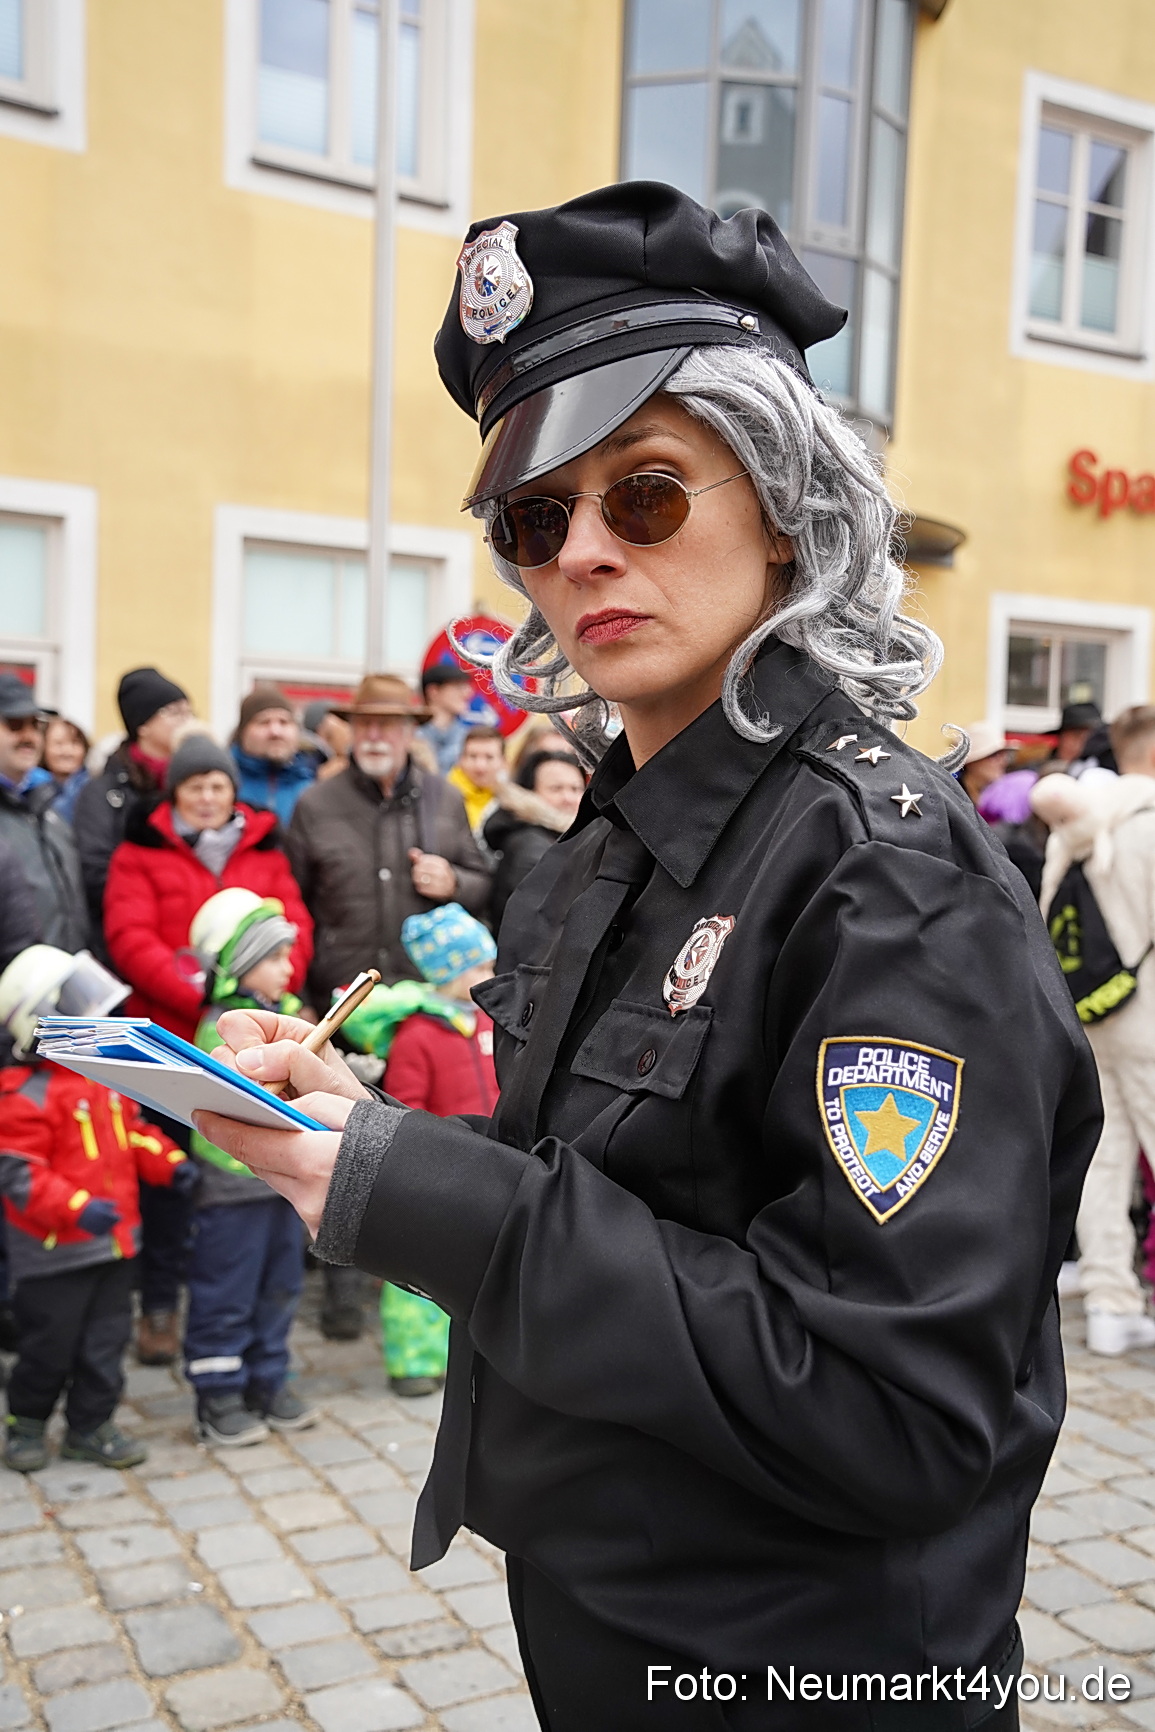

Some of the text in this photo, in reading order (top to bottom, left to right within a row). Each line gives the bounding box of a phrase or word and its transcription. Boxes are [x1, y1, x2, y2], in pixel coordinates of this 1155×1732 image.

[466, 239, 503, 265] SPECIAL
[471, 288, 515, 318] POLICE
[857, 1047, 931, 1075] POLICE
[827, 1065, 953, 1102] DEPARTMENT
[825, 1097, 842, 1121] TO
[895, 1110, 951, 1197] AND SERVE
